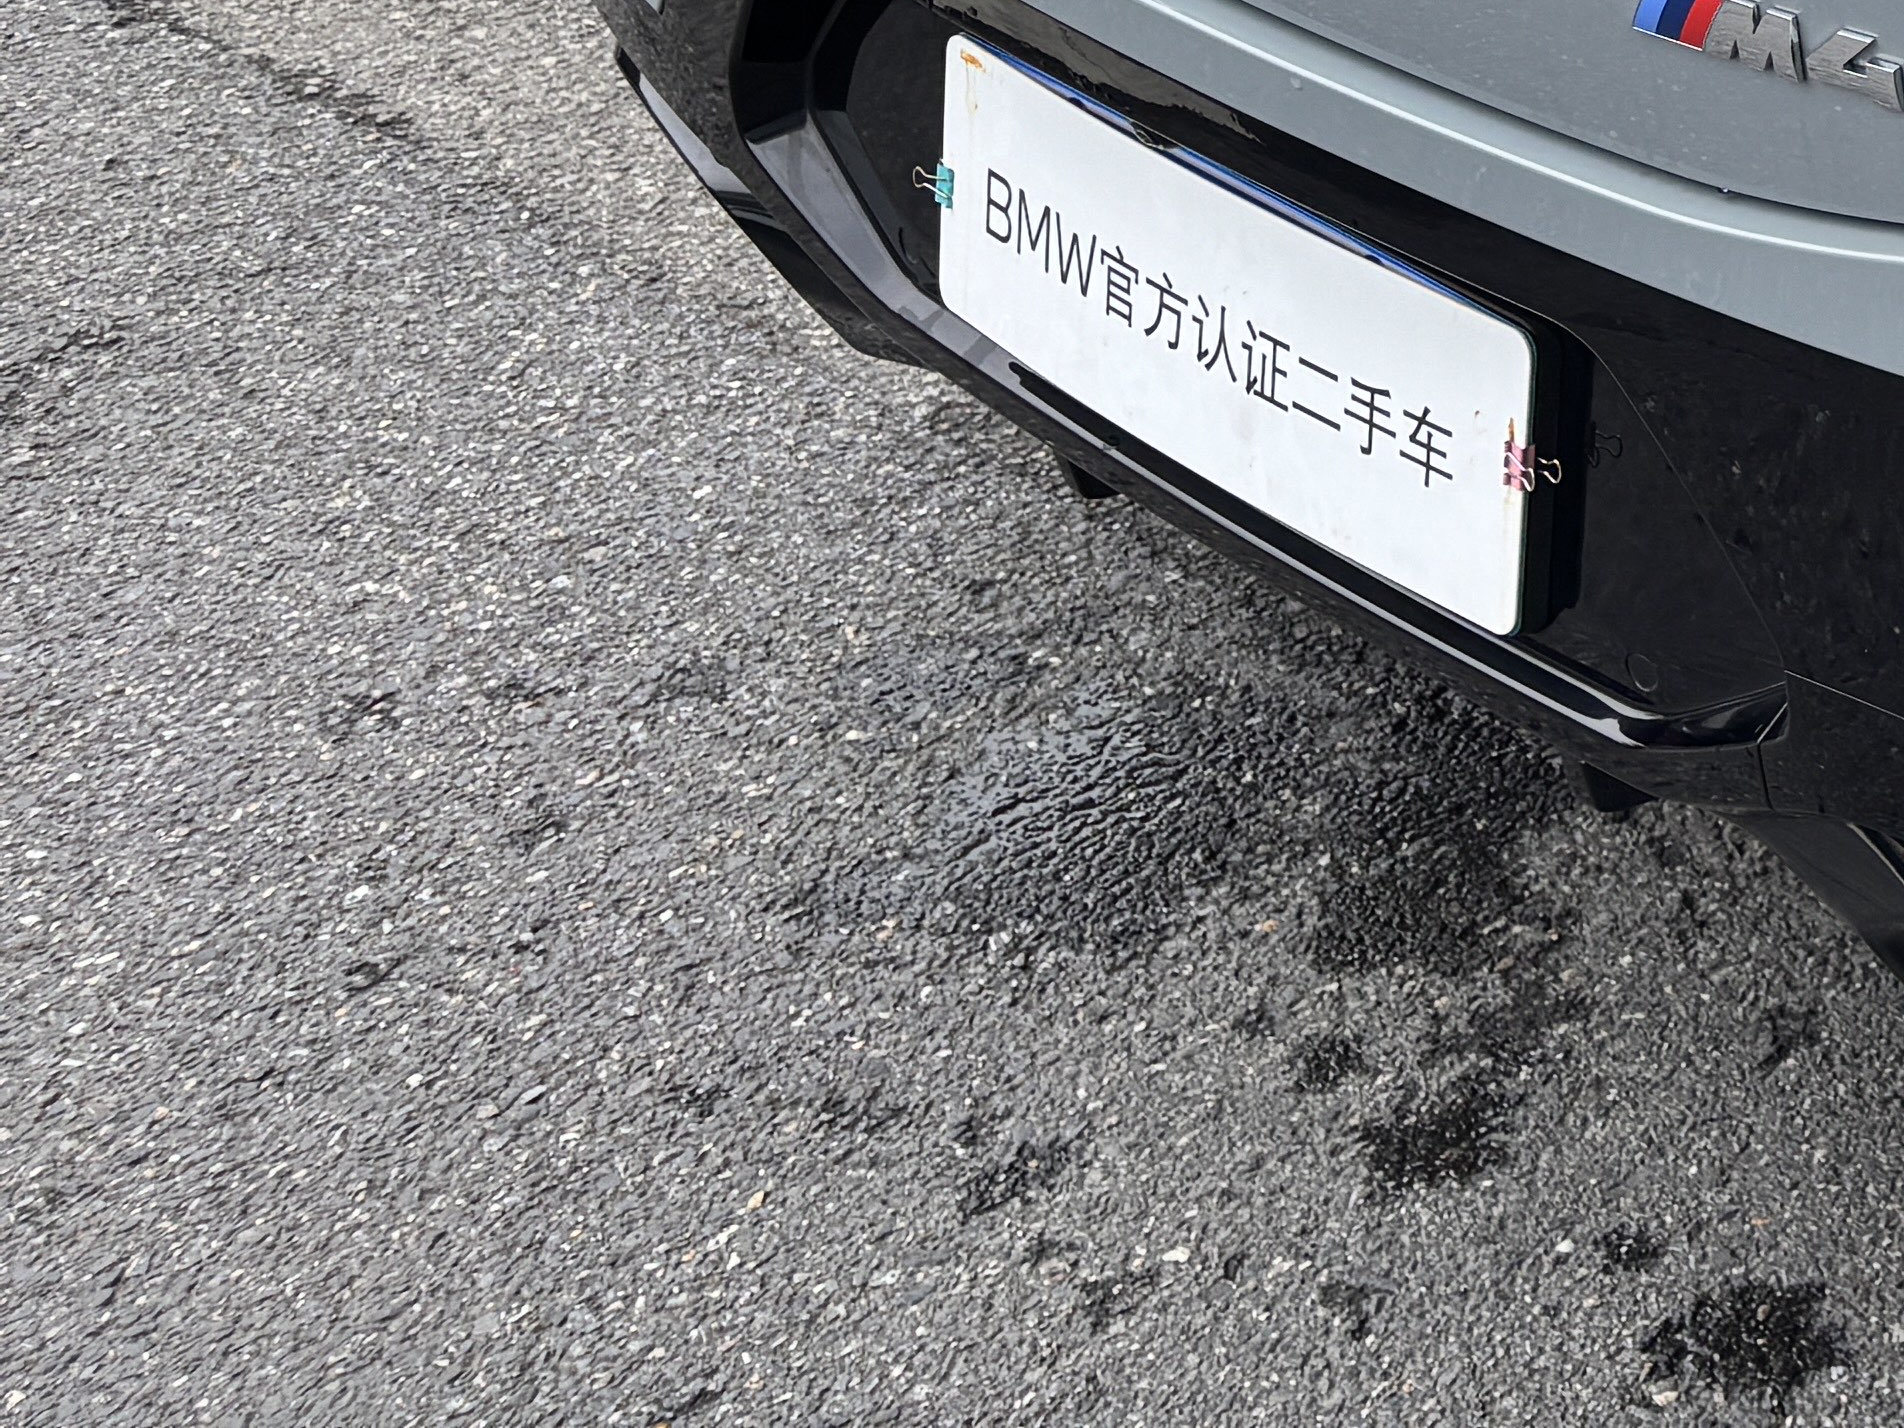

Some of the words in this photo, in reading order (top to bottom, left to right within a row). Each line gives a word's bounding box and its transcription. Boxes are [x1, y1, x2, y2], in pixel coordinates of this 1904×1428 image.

[984, 167, 1455, 488] BMW官方认证二手车
